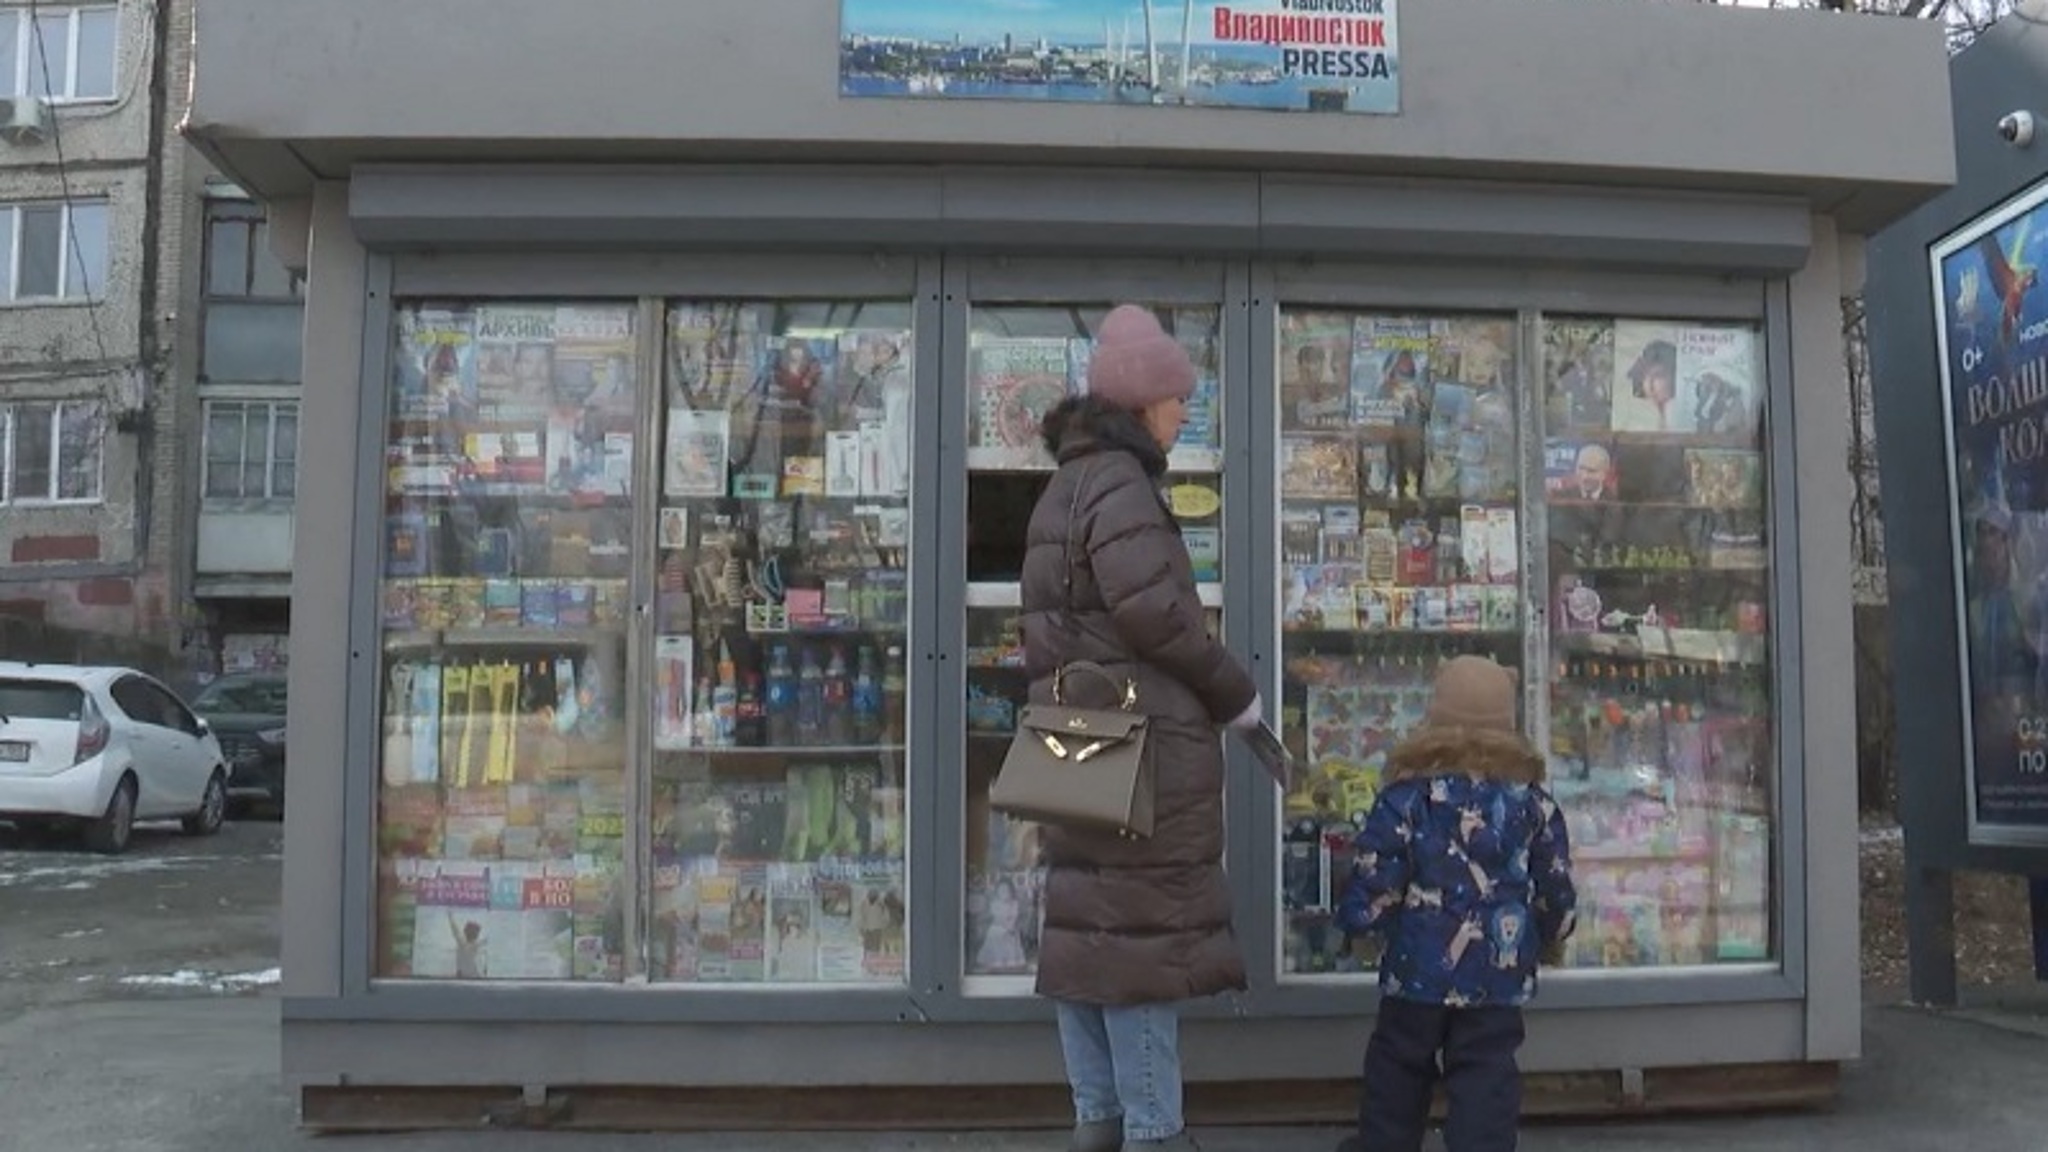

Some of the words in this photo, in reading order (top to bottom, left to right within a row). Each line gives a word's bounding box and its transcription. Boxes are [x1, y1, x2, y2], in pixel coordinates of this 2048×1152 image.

[1214, 7, 1386, 46] Владивосток
[1282, 48, 1389, 79] PRESSA
[1962, 346, 1983, 372] 0+
